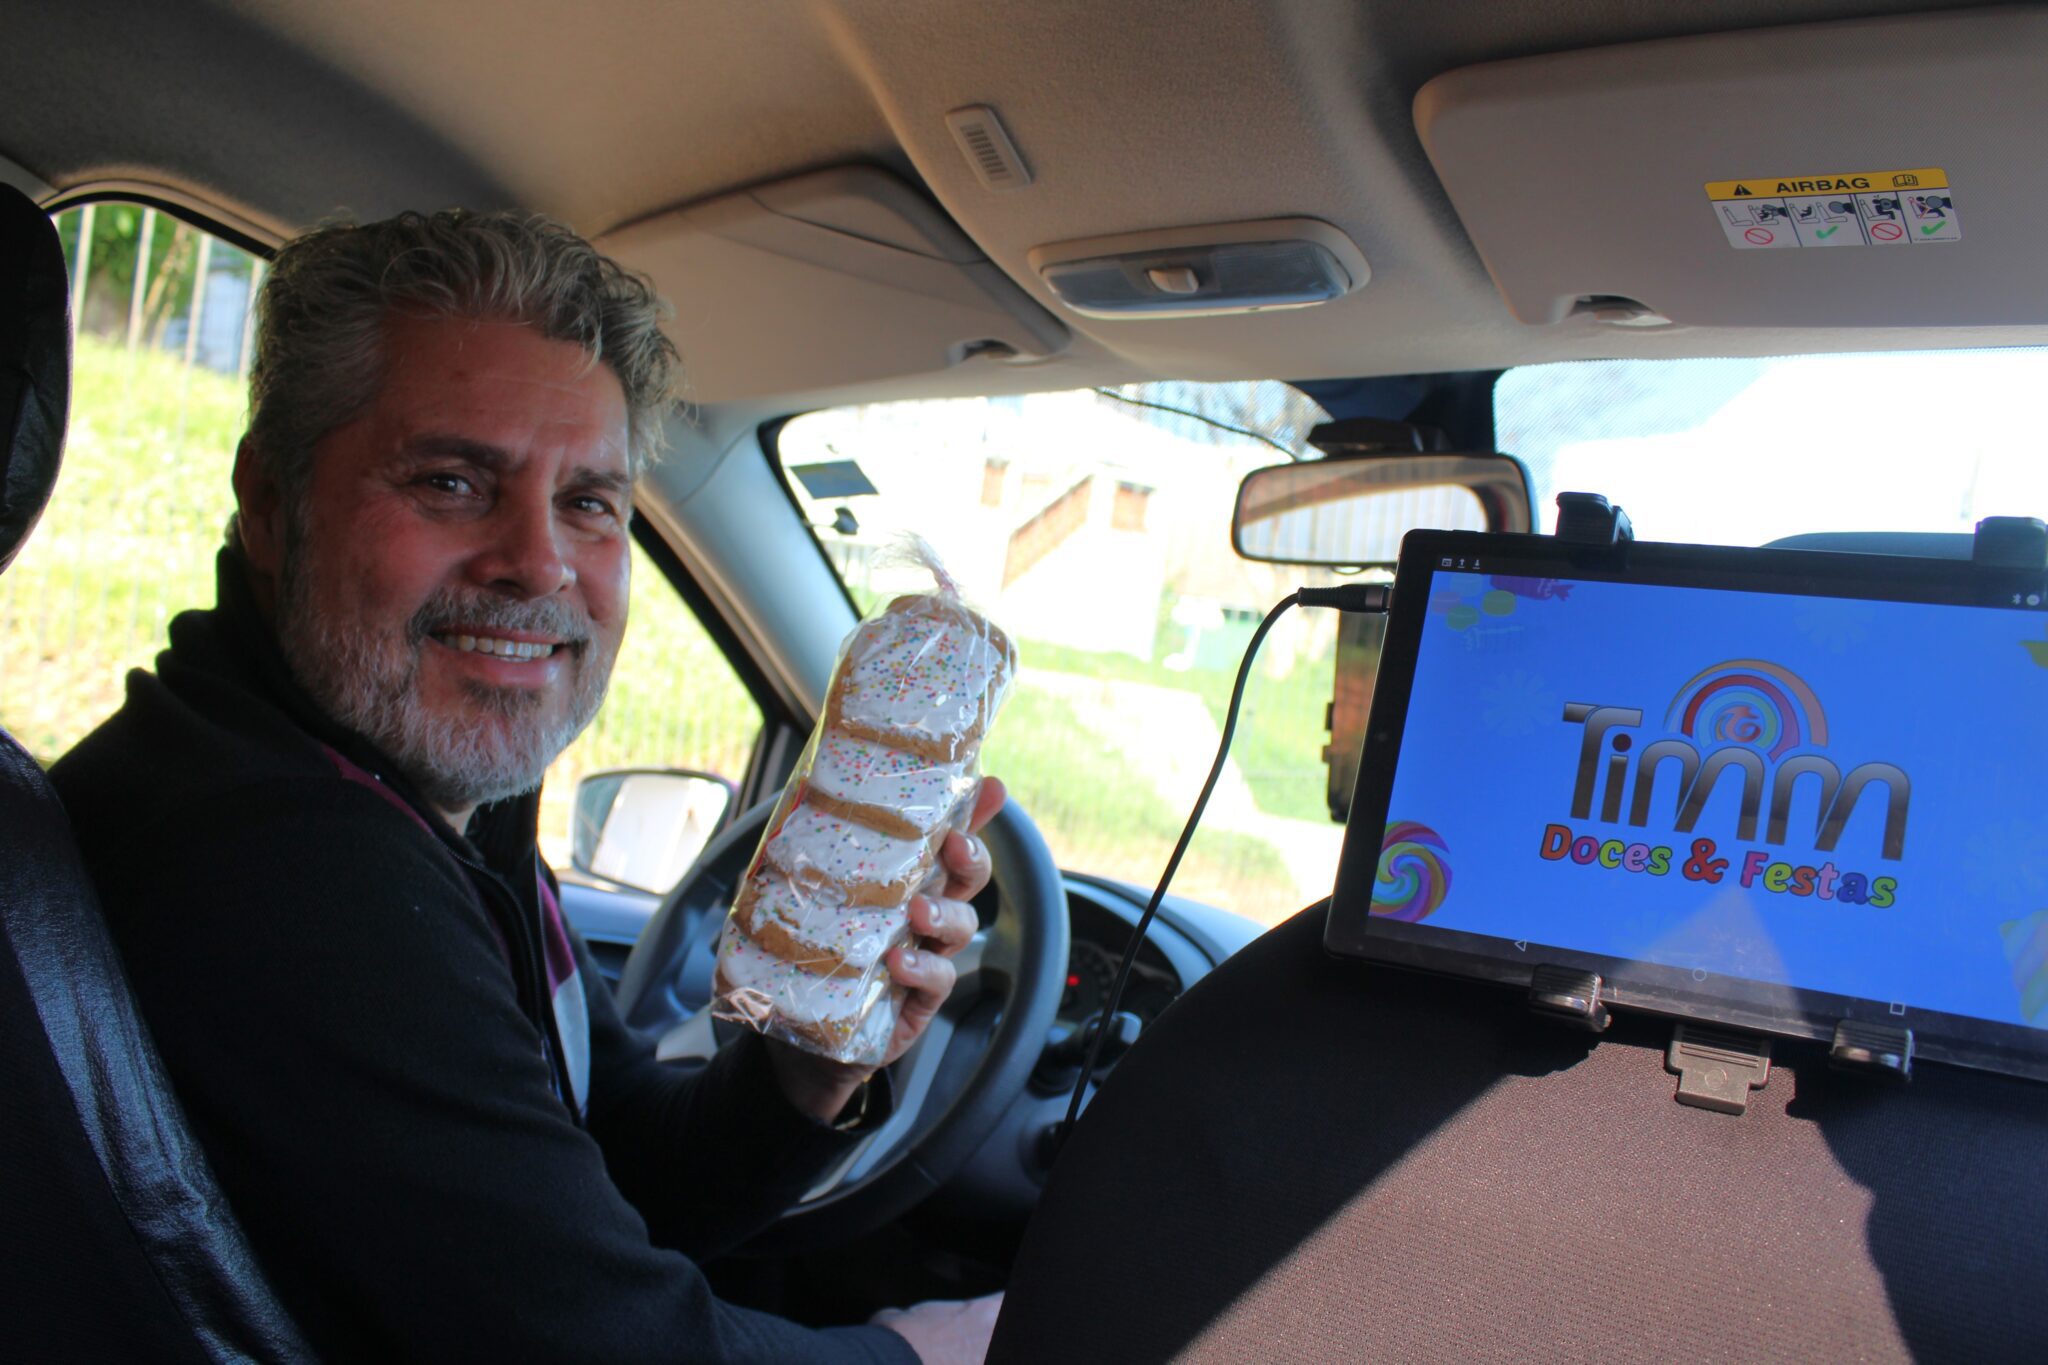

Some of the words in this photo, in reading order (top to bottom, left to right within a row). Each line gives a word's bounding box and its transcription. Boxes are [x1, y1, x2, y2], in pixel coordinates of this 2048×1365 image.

[1777, 177, 1870, 193] AIRBAG
[1540, 823, 1673, 876] Doces
[1681, 837, 1729, 884] &
[1739, 850, 1897, 908] Festas
